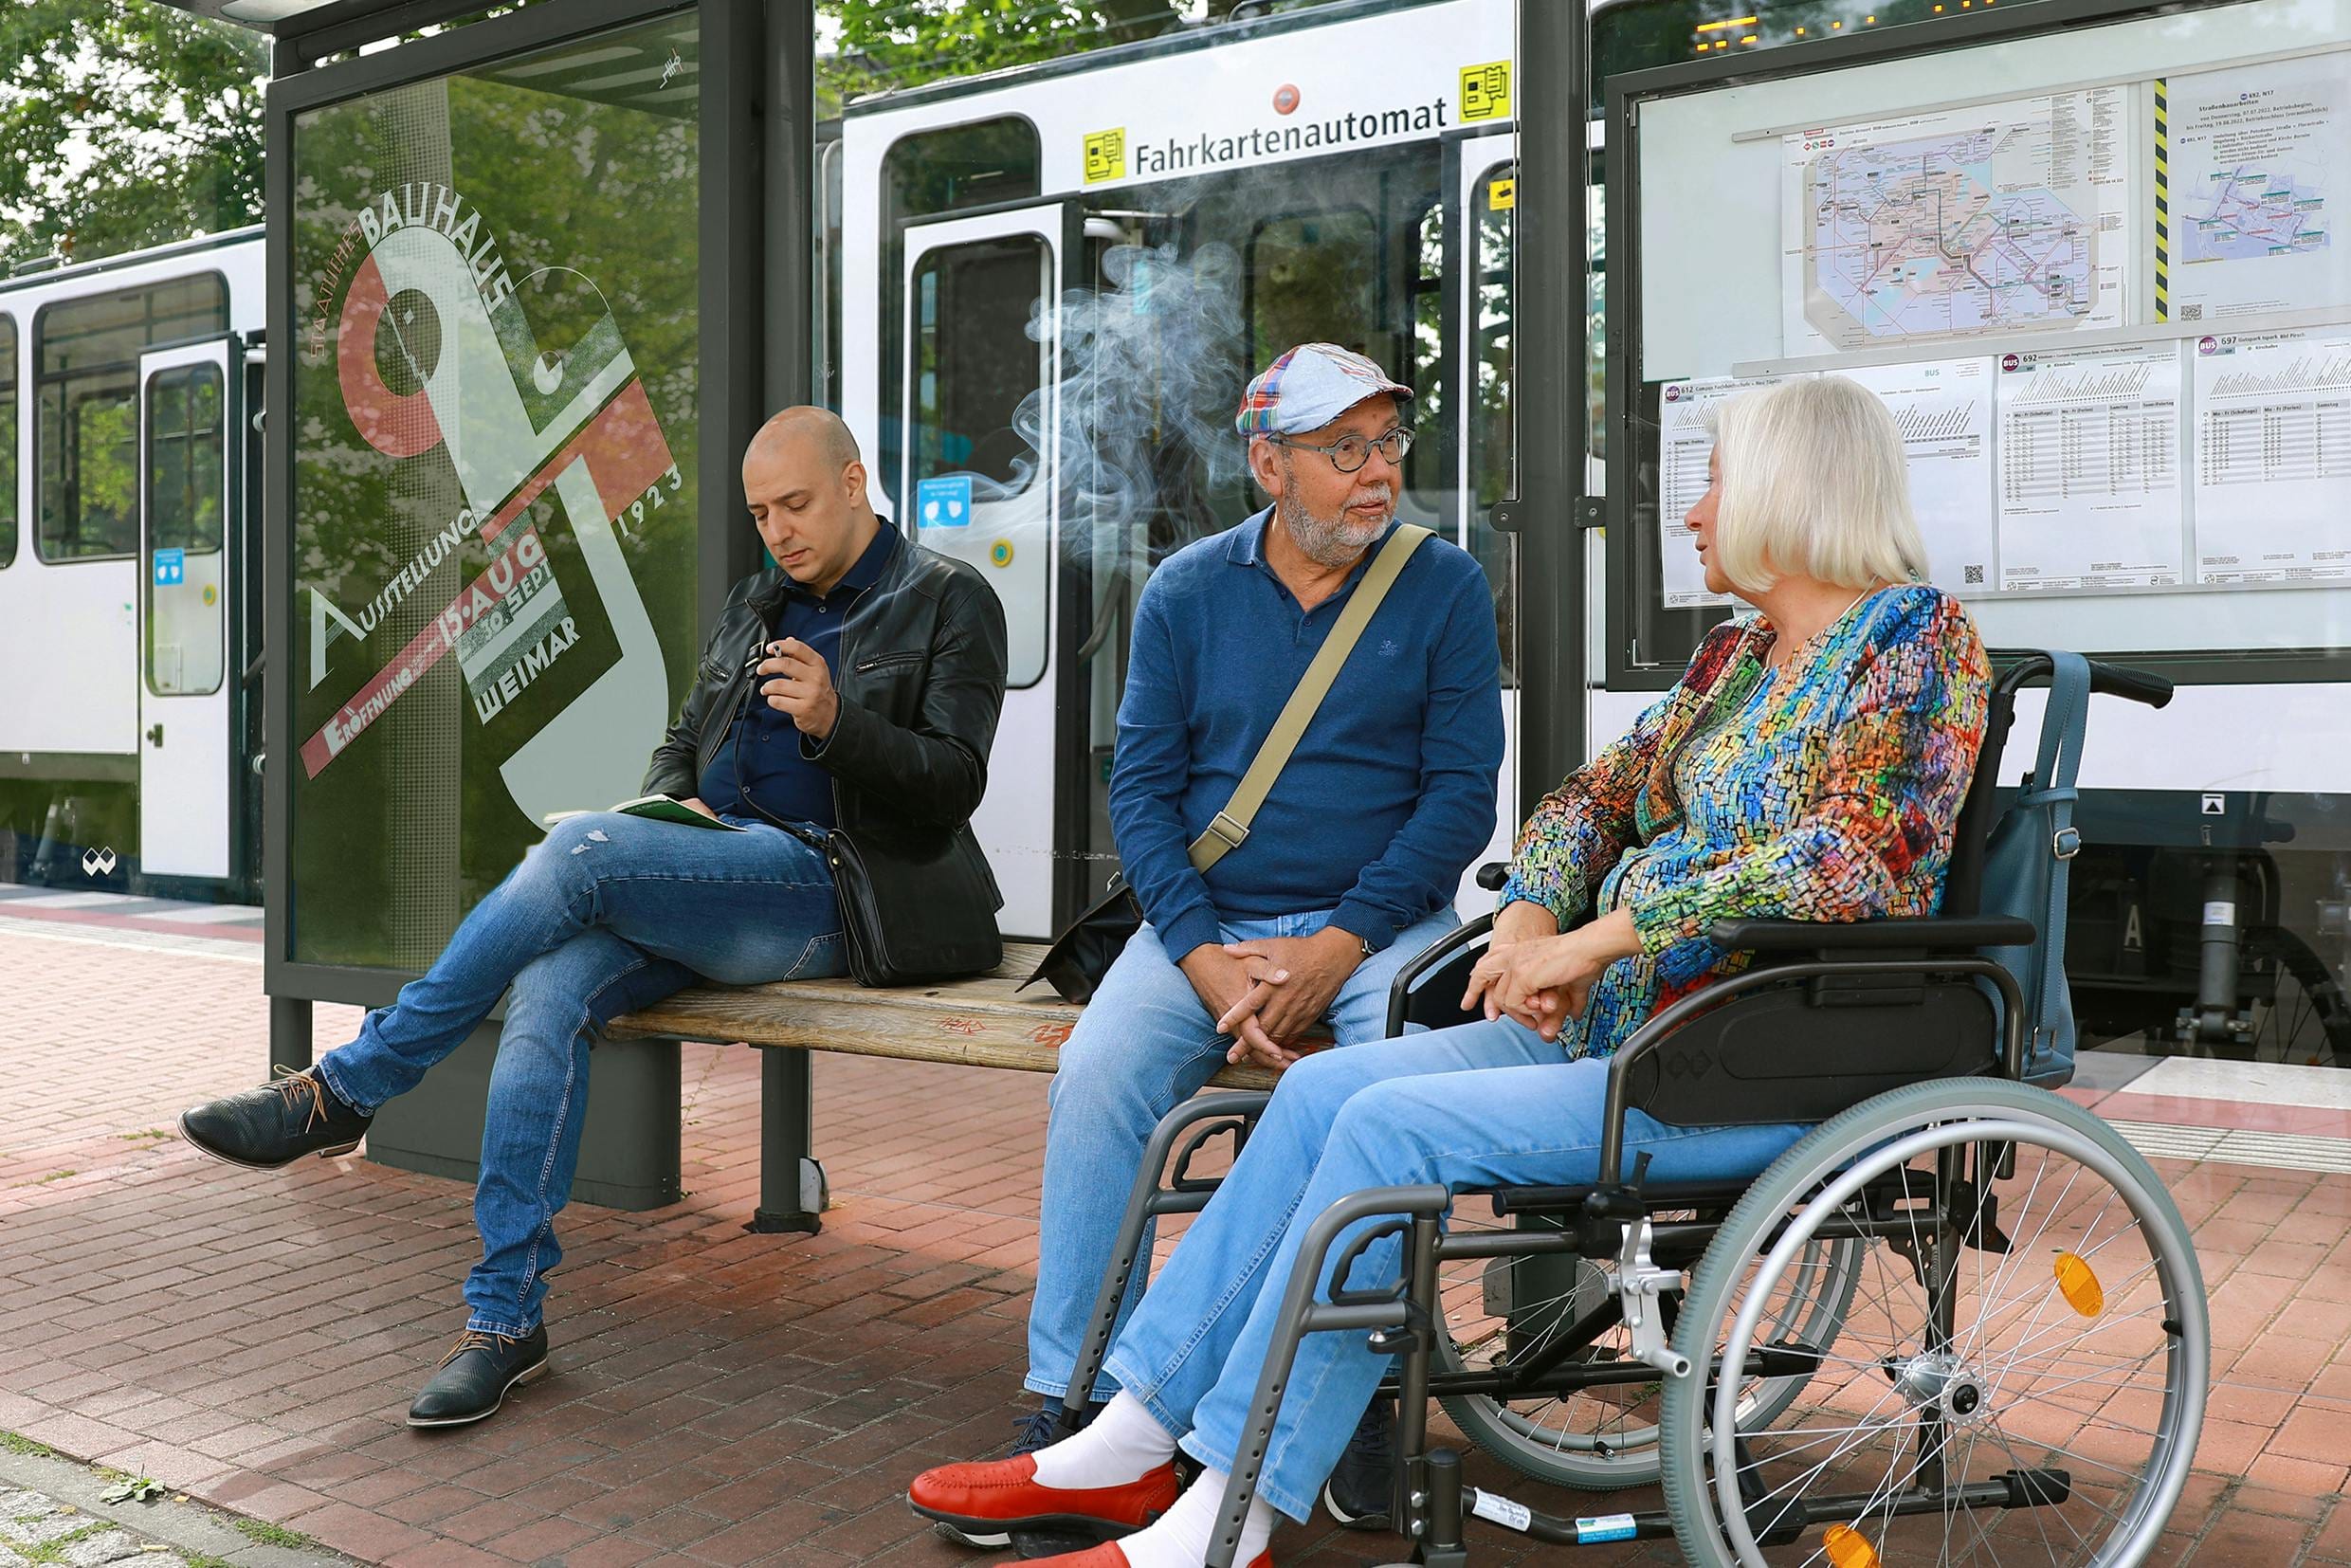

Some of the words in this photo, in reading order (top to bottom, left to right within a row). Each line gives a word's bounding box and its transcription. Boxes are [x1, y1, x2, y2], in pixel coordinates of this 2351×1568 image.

[1136, 97, 1447, 174] Fahrkartenautomat
[357, 181, 515, 316] BAUHAUS
[1924, 369, 1941, 377] BUS
[2003, 358, 2018, 367] BUS
[2023, 355, 2037, 363] 692
[2221, 337, 2237, 345] 697
[617, 463, 682, 538] 1923
[305, 509, 477, 695] AUSSTELLUNG
[505, 560, 555, 614] SEPT
[474, 616, 581, 727] WEIMAR
[322, 666, 414, 757] ERÖFFNUNG
[2124, 904, 2142, 947] A
